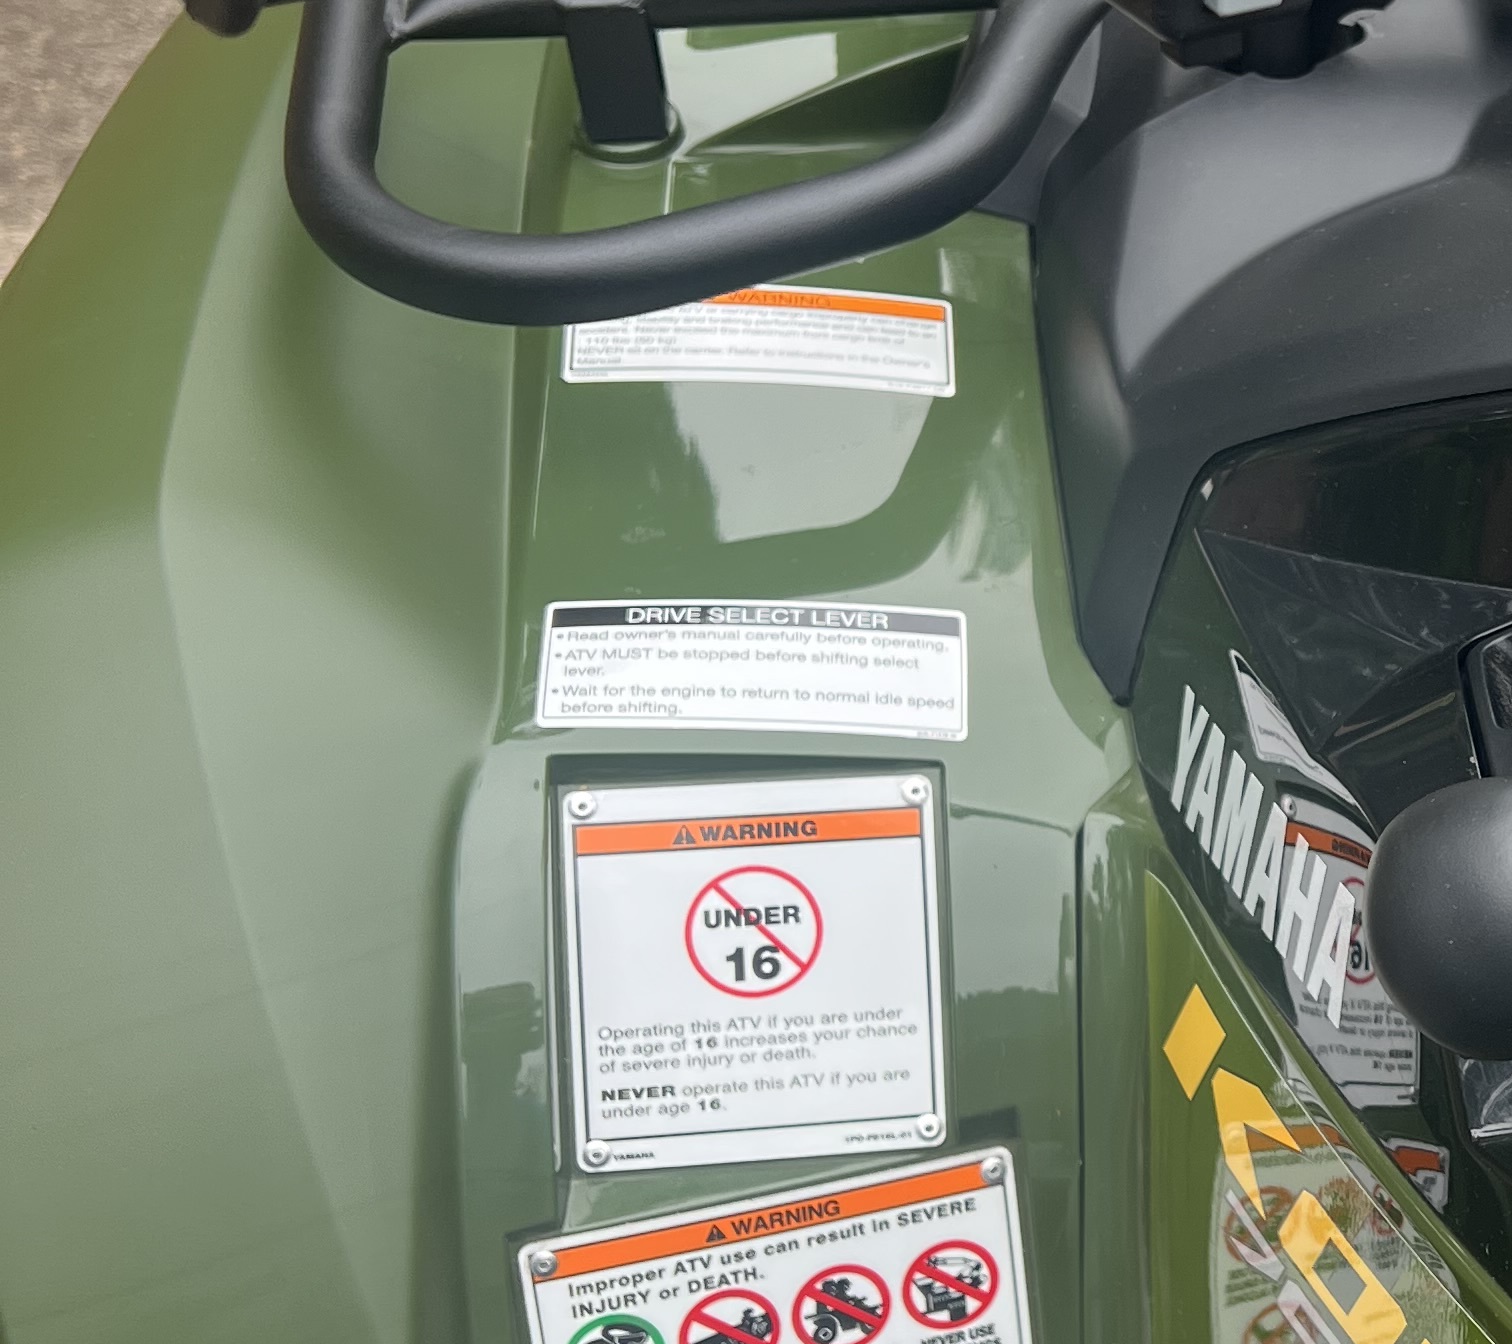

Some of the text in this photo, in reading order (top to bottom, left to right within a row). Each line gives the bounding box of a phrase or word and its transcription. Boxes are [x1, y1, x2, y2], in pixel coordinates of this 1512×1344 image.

[627, 606, 888, 629] DRIVE SELECT LEVER
[566, 629, 948, 652] Read owner's manual carefully before operating.
[563, 665, 605, 677] lever.
[564, 646, 919, 669] ATV MUST be stopped before shifting select
[560, 700, 683, 717] before shifting.
[561, 683, 954, 710] Wait for the engine to return to normal idle speed
[697, 818, 817, 844] WARNING
[1171, 684, 1356, 1029] YAMAHA
[703, 902, 800, 931] UNDER
[725, 942, 784, 982] 16
[597, 1006, 902, 1043] Operating this ATV if you are under
[597, 1022, 917, 1057] the age of 16 increases your chance
[598, 1044, 815, 1074] of severe injury or death.
[601, 1070, 909, 1102] NEVER operate this ATV if you are
[601, 1096, 726, 1119] under age 16.
[727, 1196, 842, 1239] WARNING
[567, 1196, 976, 1300] Improper ATV use can result in SEVERE
[571, 1264, 764, 1318] INJURY or DEATH.
